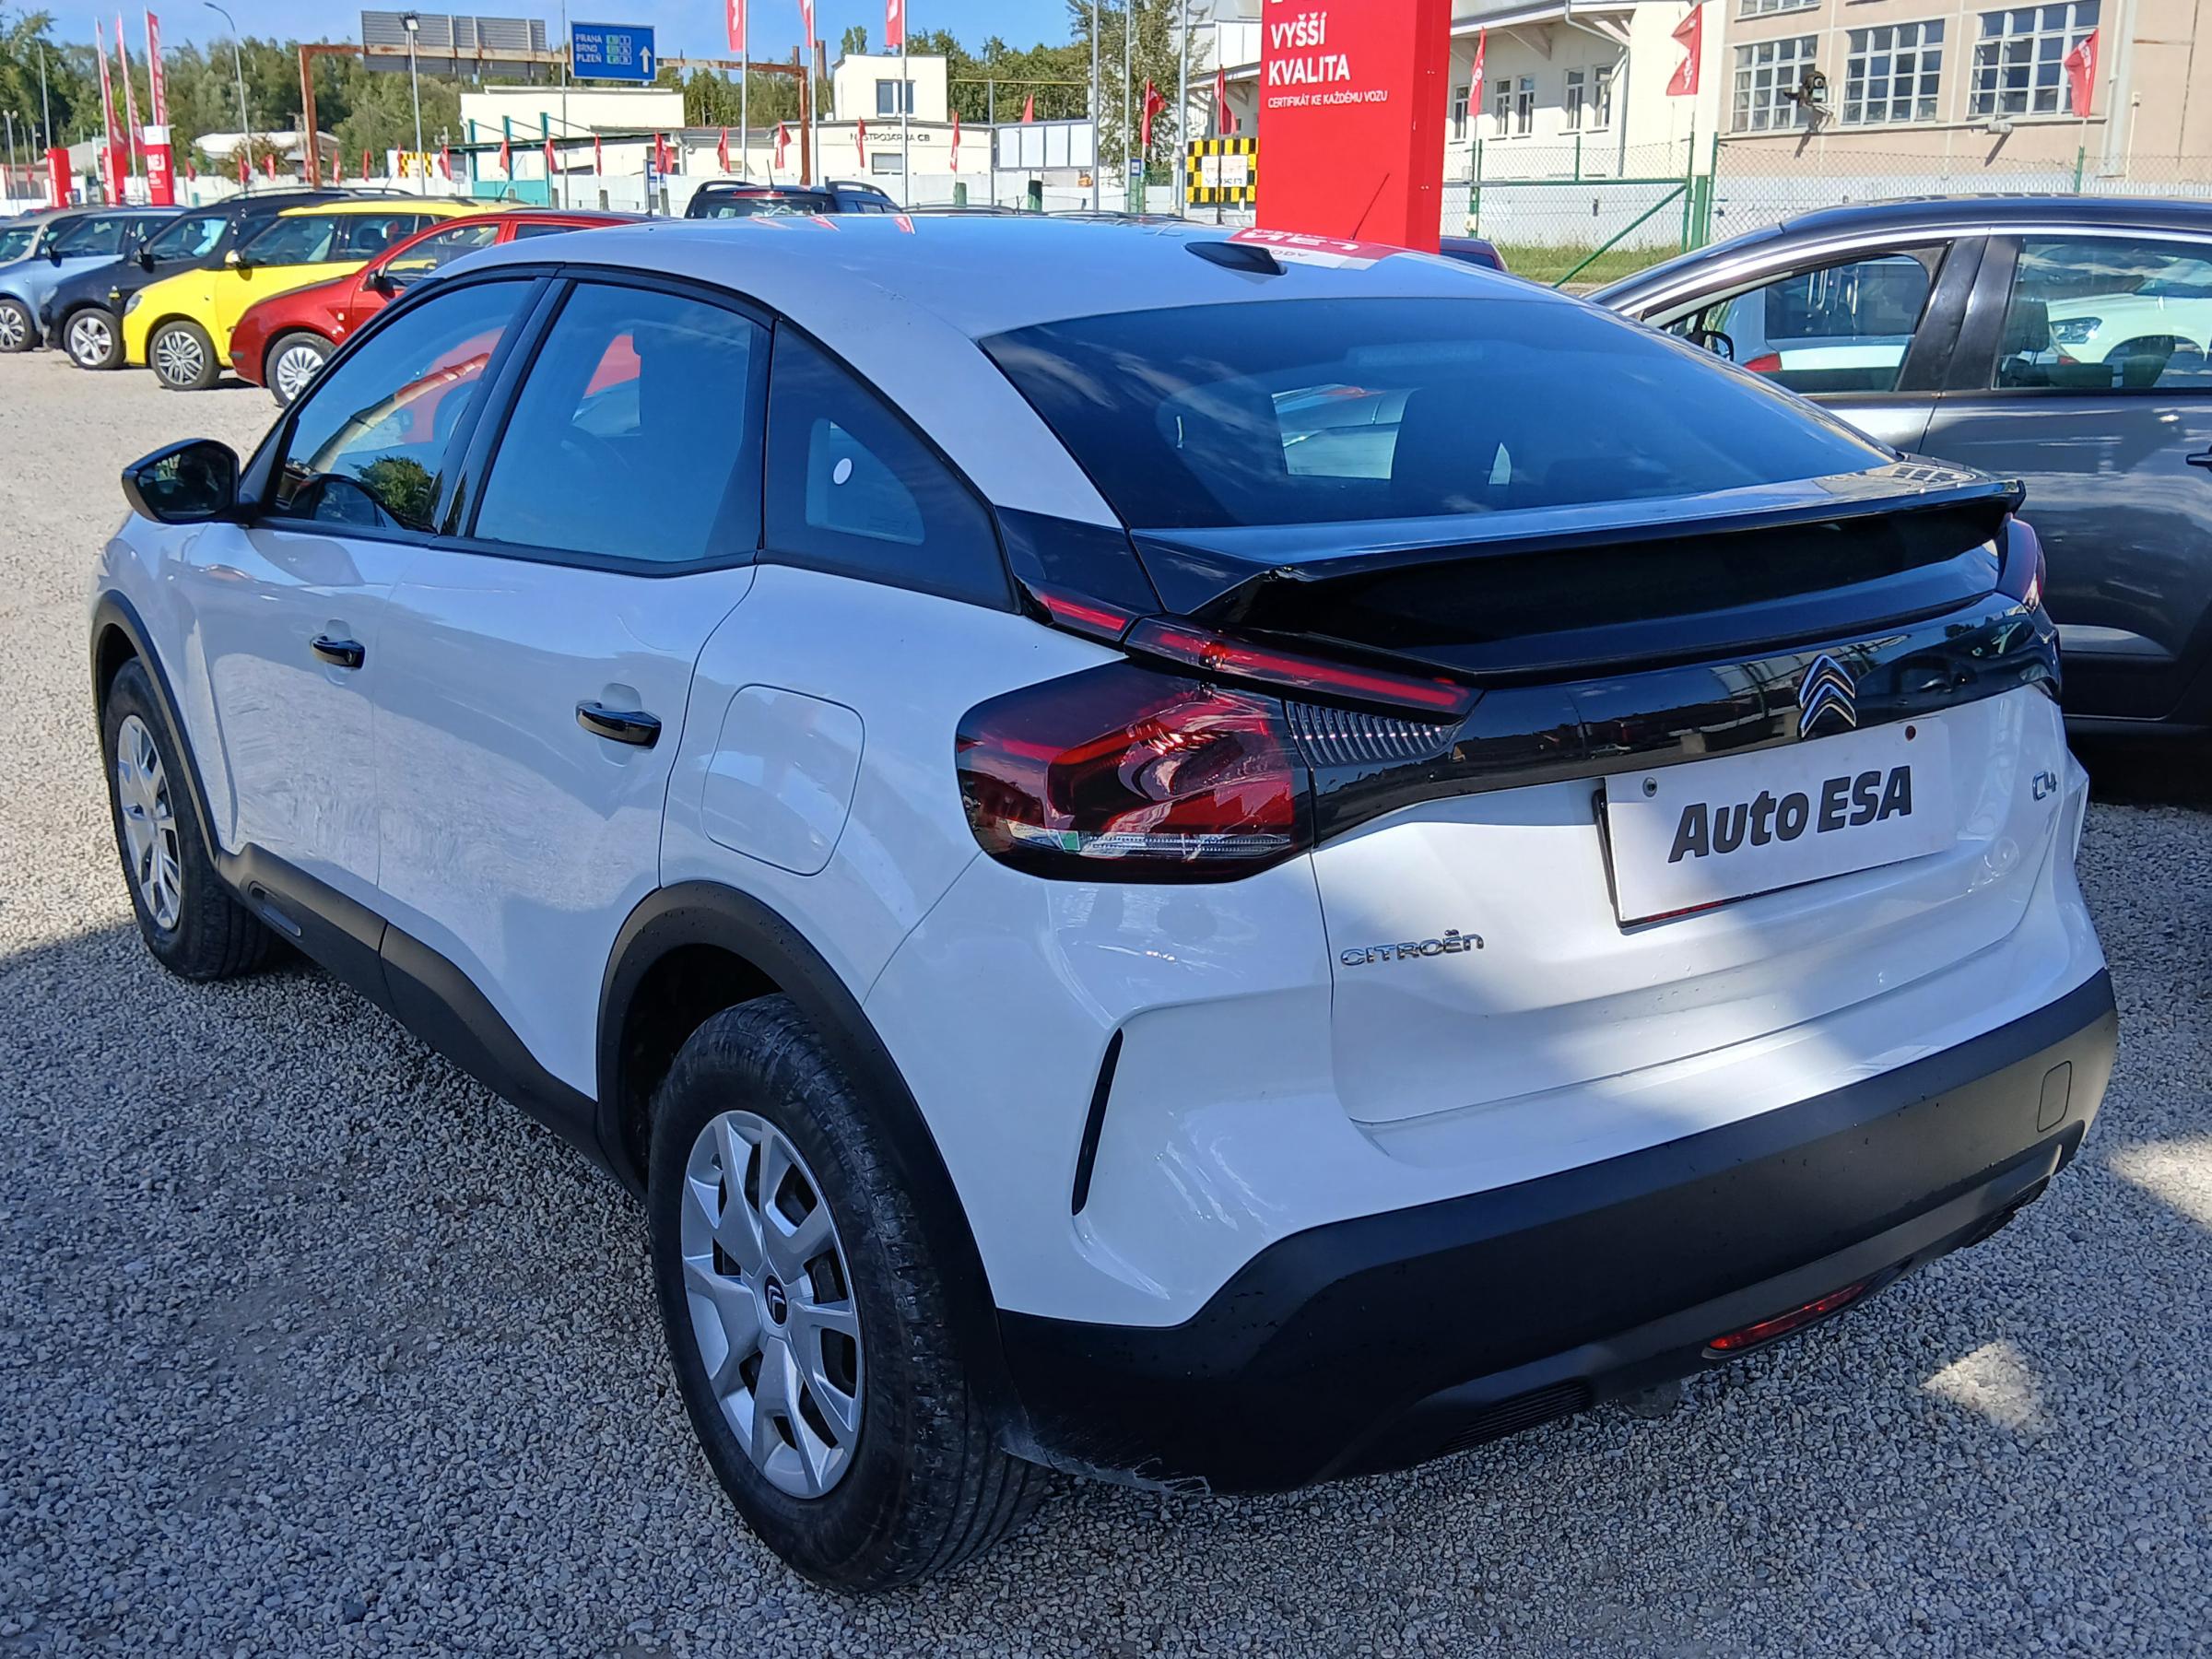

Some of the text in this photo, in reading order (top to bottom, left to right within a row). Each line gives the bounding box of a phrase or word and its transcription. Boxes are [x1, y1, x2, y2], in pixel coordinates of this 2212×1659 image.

[575, 33, 602, 43] PRAHA
[1271, 11, 1327, 49] VYŠŠÍ
[575, 43, 597, 53] BRNO
[1268, 53, 1350, 86] KVALITA
[1267, 90, 1388, 108] CERTIFIKÁT KE KAŽDÉMU VOZU
[2031, 771, 2057, 802] C4
[1667, 766, 1912, 863] Auto ESA
[1340, 929, 1484, 966] CITROËN
